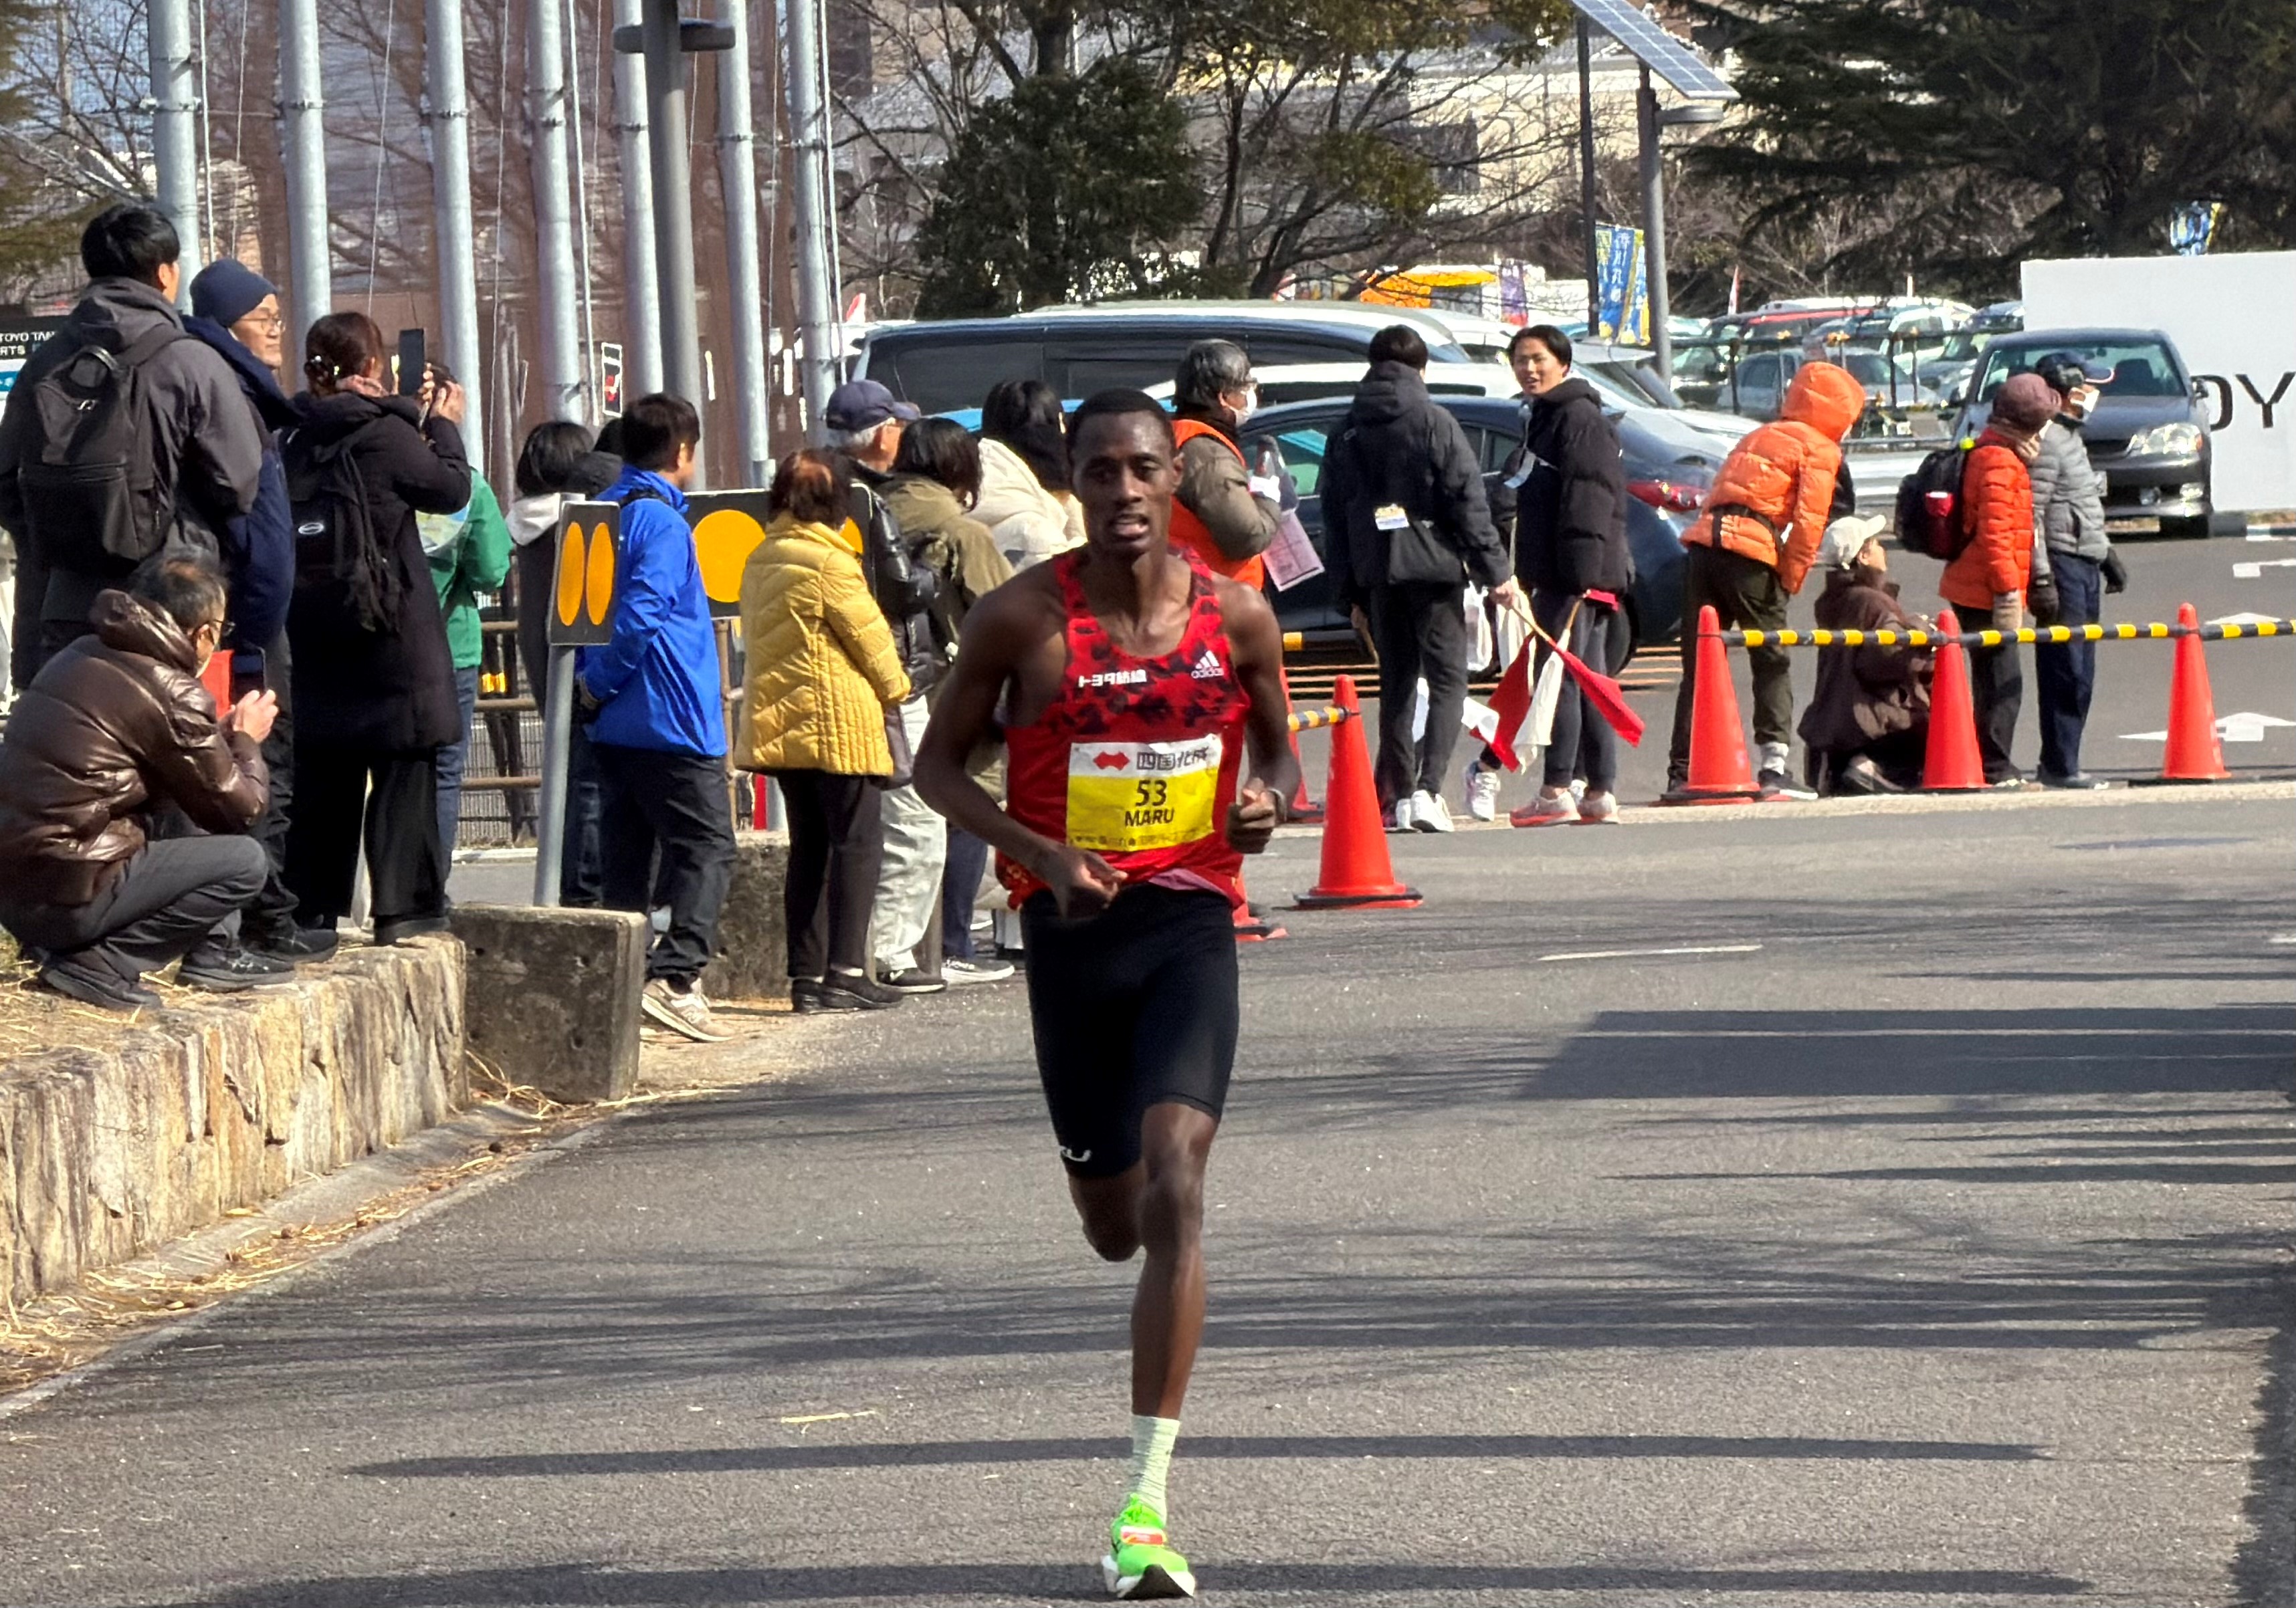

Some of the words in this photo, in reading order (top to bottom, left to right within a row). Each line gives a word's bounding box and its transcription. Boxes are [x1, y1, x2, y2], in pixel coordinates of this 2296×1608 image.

[1191, 667, 1225, 679] adidas
[1135, 780, 1168, 806] 53
[1124, 808, 1175, 826] MARU
